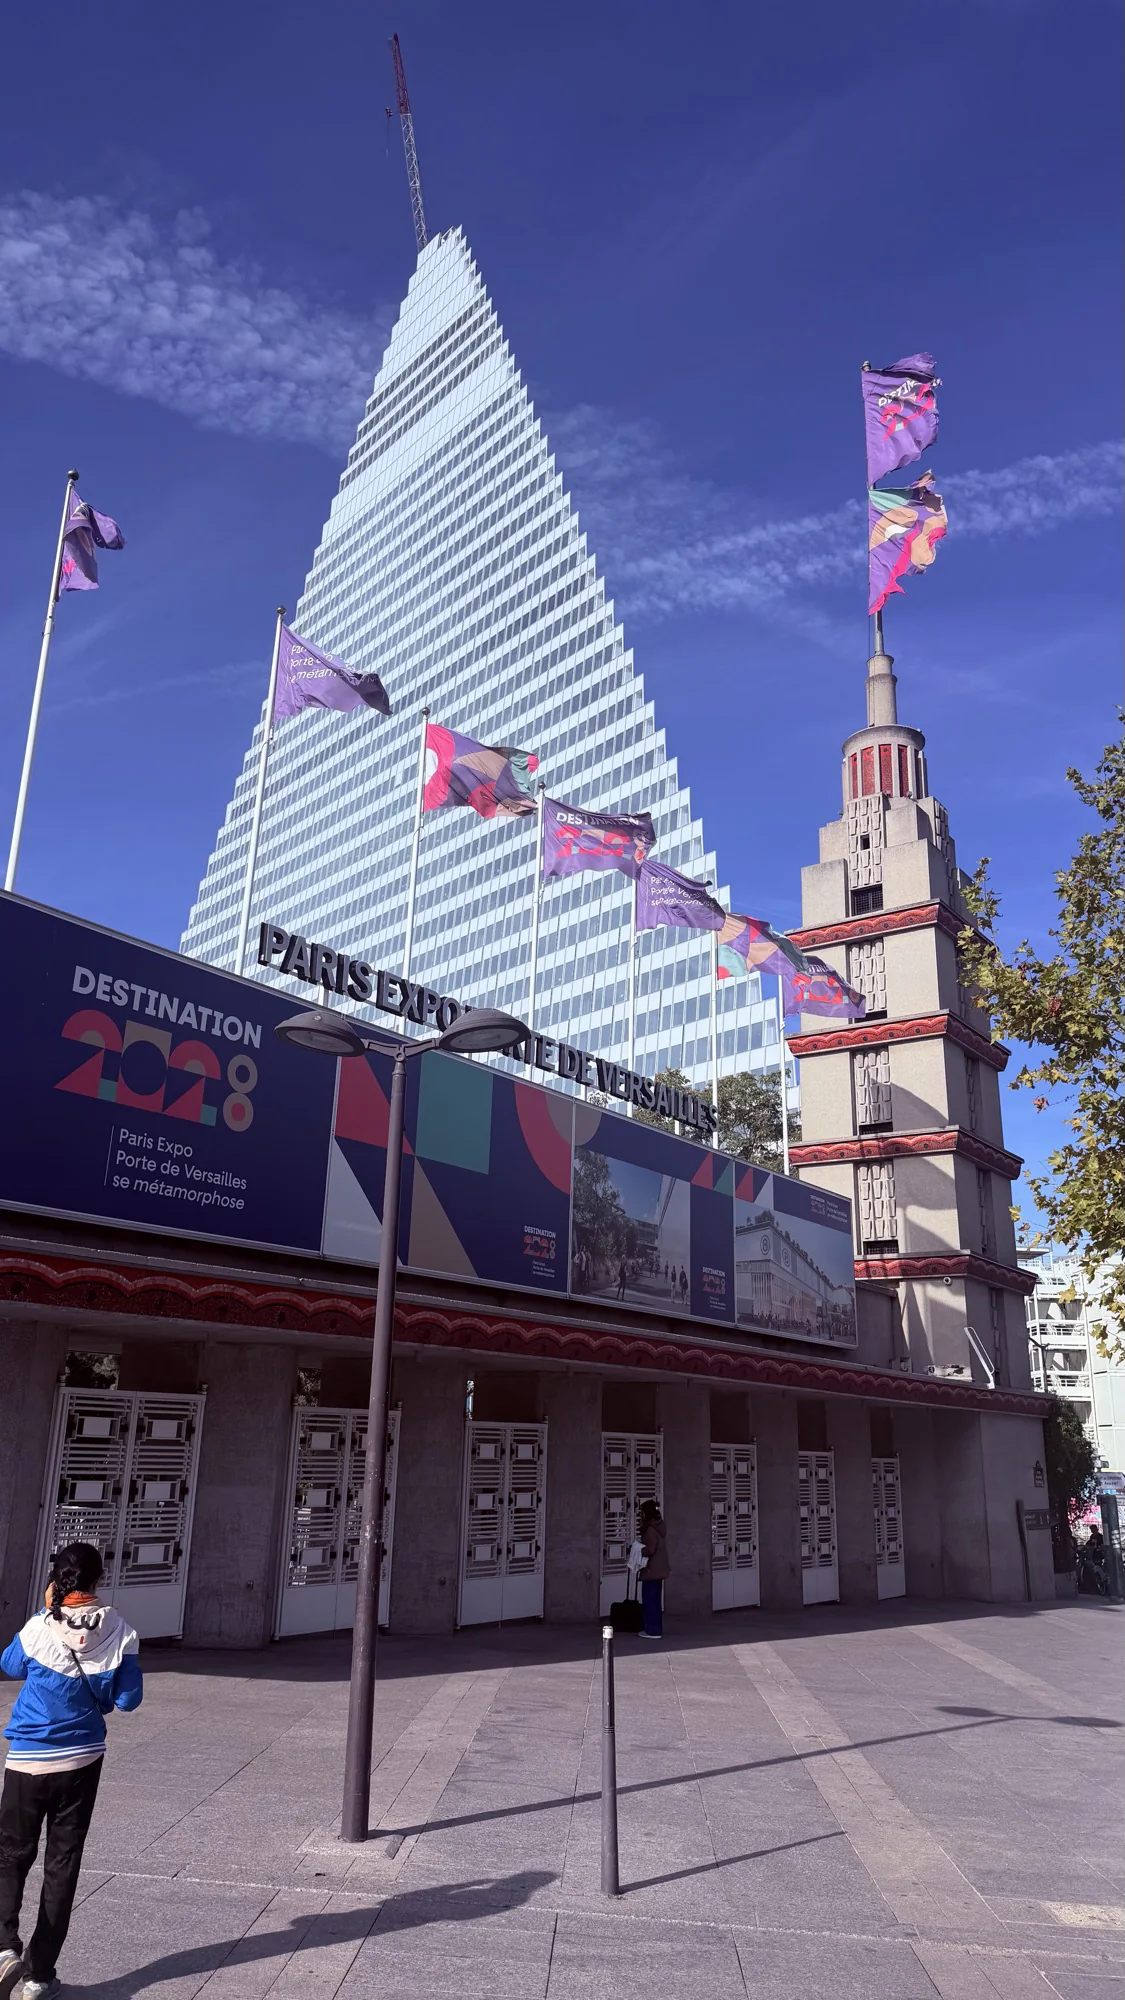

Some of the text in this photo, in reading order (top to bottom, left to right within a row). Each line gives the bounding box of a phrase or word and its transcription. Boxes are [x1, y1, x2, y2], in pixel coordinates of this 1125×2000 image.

[556, 812, 640, 826] DESTINATION
[72, 965, 262, 1049] DESTINATION
[258, 922, 373, 1002] PARIS
[376, 970, 461, 1033] EXPO
[558, 1043, 595, 1086] DE
[596, 1057, 719, 1132] VERSAILLES
[54, 1009, 258, 1132] 2028
[119, 1128, 193, 1158] Paris Expo
[115, 1150, 248, 1190] Porte de Versailles
[112, 1174, 246, 1210] se métamorphose
[523, 1225, 556, 1239] DESTINATION
[523, 1235, 556, 1260] 2028
